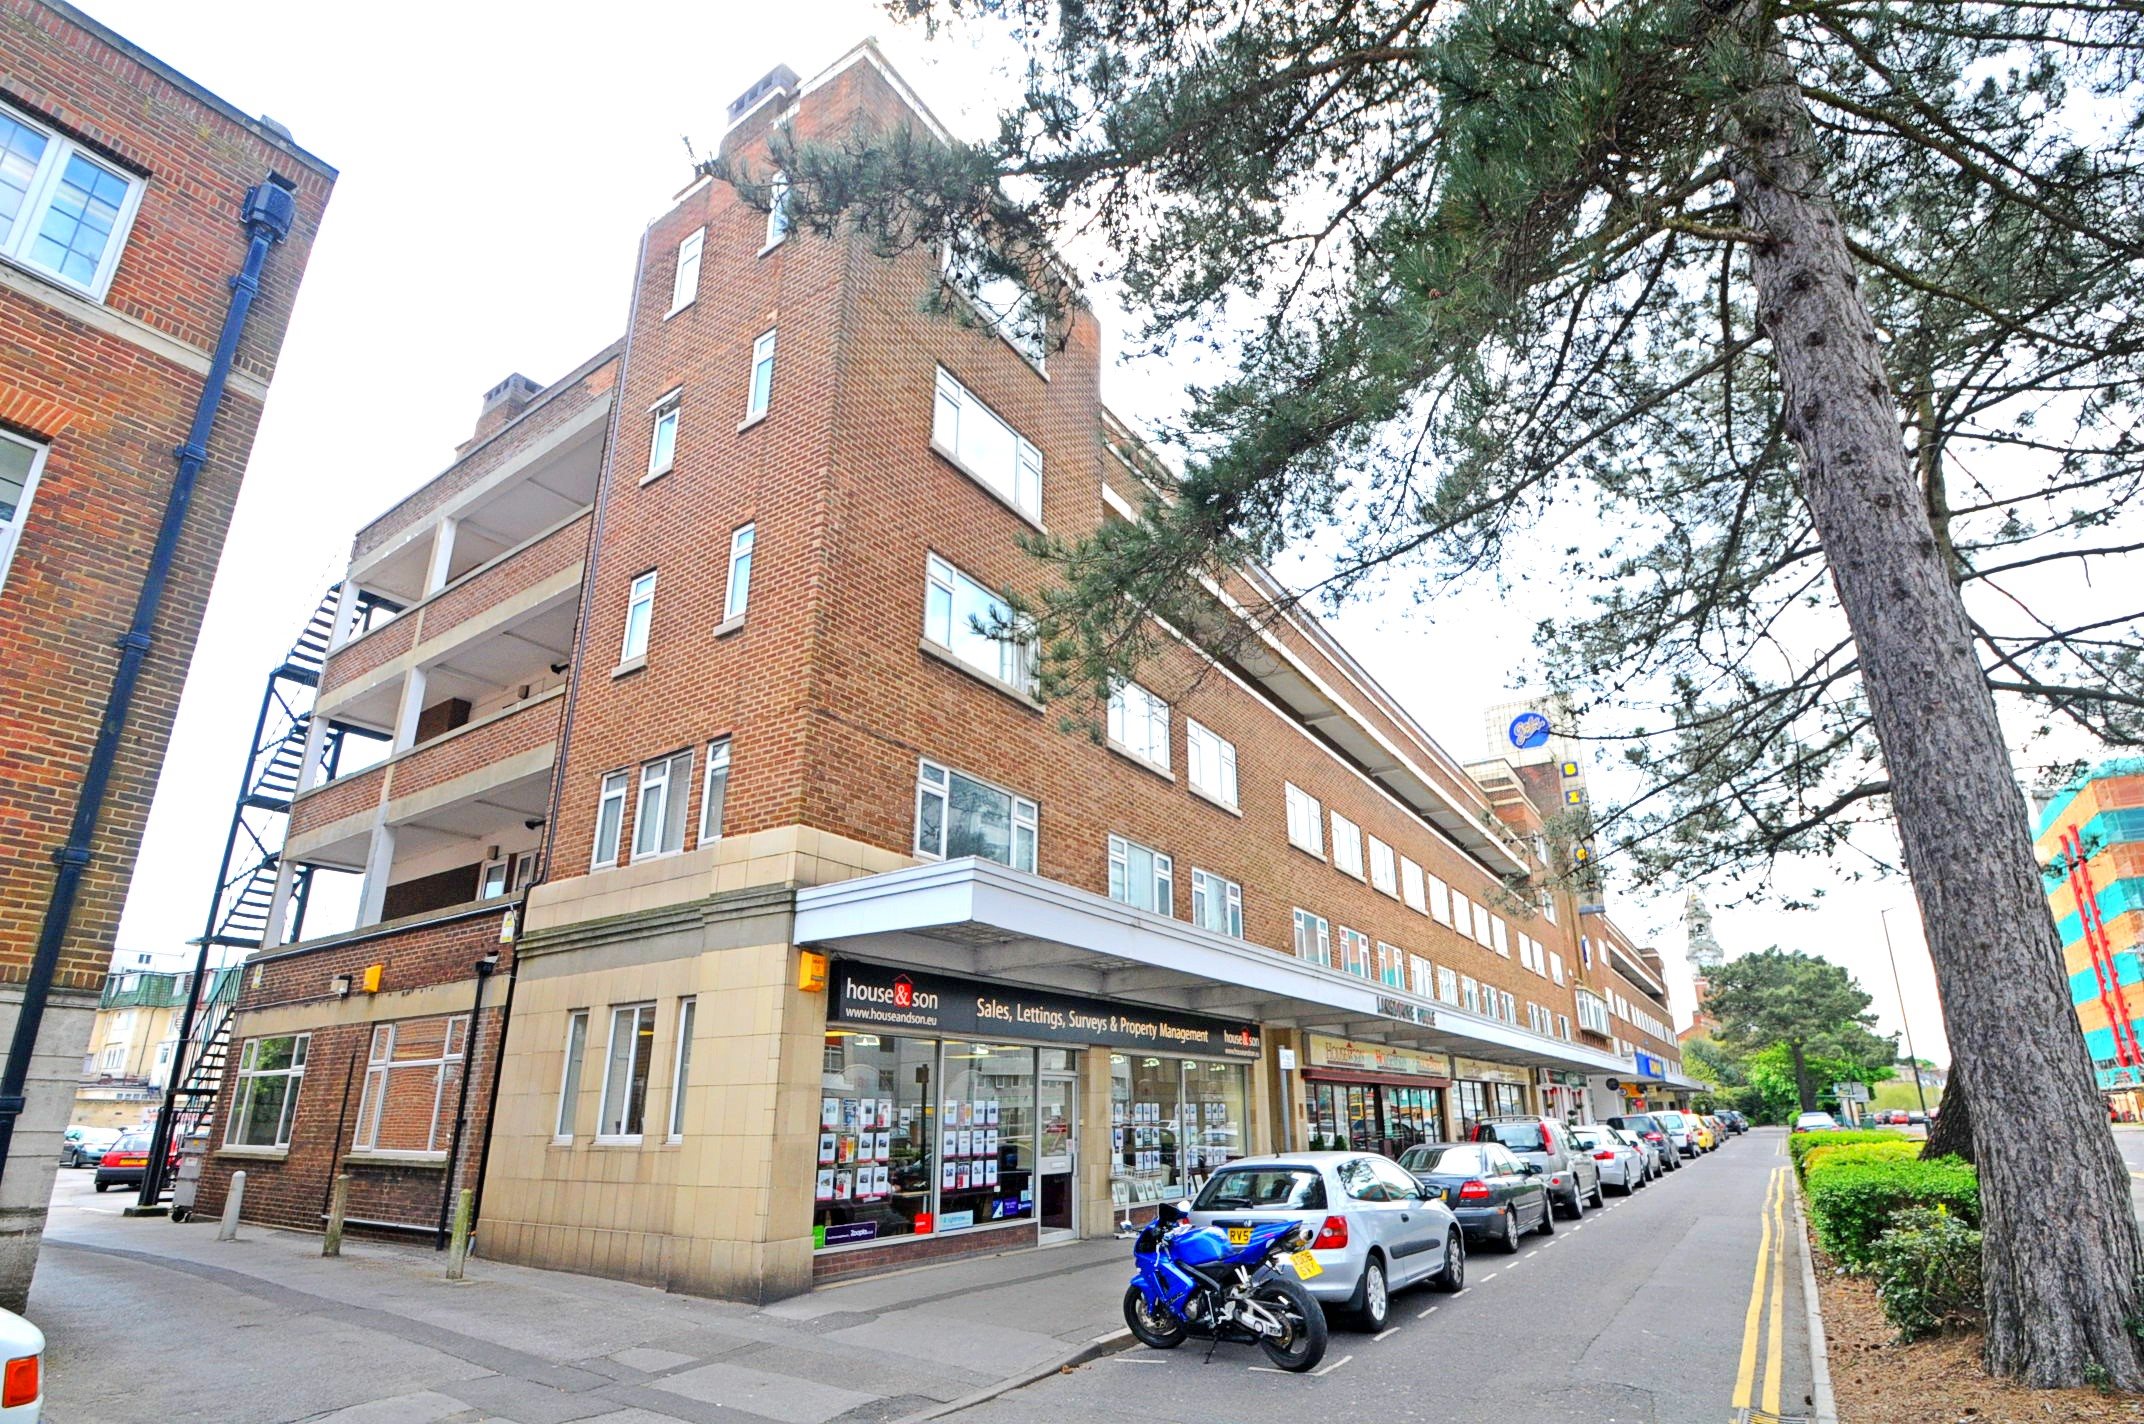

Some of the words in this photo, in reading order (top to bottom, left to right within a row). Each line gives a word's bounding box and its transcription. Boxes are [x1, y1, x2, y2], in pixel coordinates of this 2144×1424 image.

[845, 1007, 937, 1026] www.houseandson.eu
[977, 998, 1012, 1023] Sales,
[1017, 1003, 1066, 1030] Lettings,
[1069, 1010, 1107, 1034] Surveys
[1109, 1016, 1118, 1032] &
[1121, 1017, 1157, 1040] Property
[1160, 1022, 1208, 1044] Management
